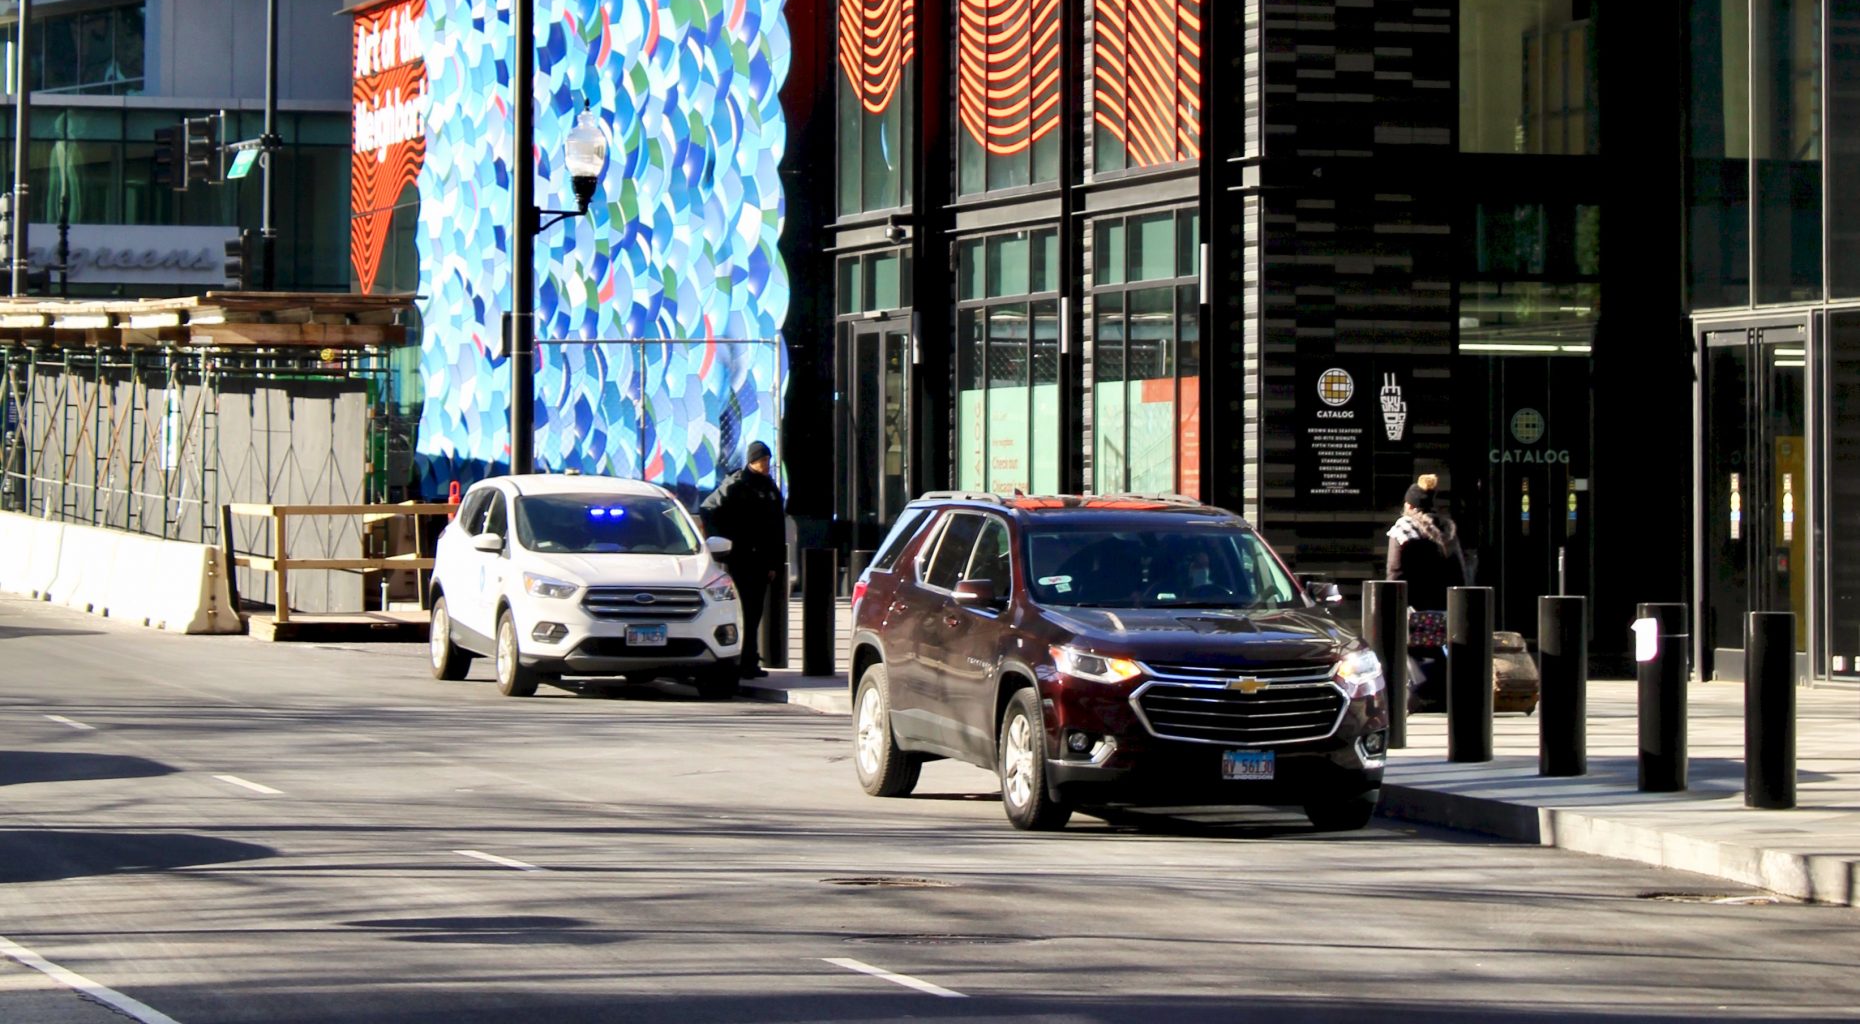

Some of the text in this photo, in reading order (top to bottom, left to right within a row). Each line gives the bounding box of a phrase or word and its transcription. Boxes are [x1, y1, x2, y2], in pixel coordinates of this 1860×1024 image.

[356, 20, 380, 77] Art
[381, 9, 397, 70] of
[28, 245, 215, 276] algreens
[1316, 410, 1354, 418] CATALOG
[1489, 449, 1570, 464] CATALOG
